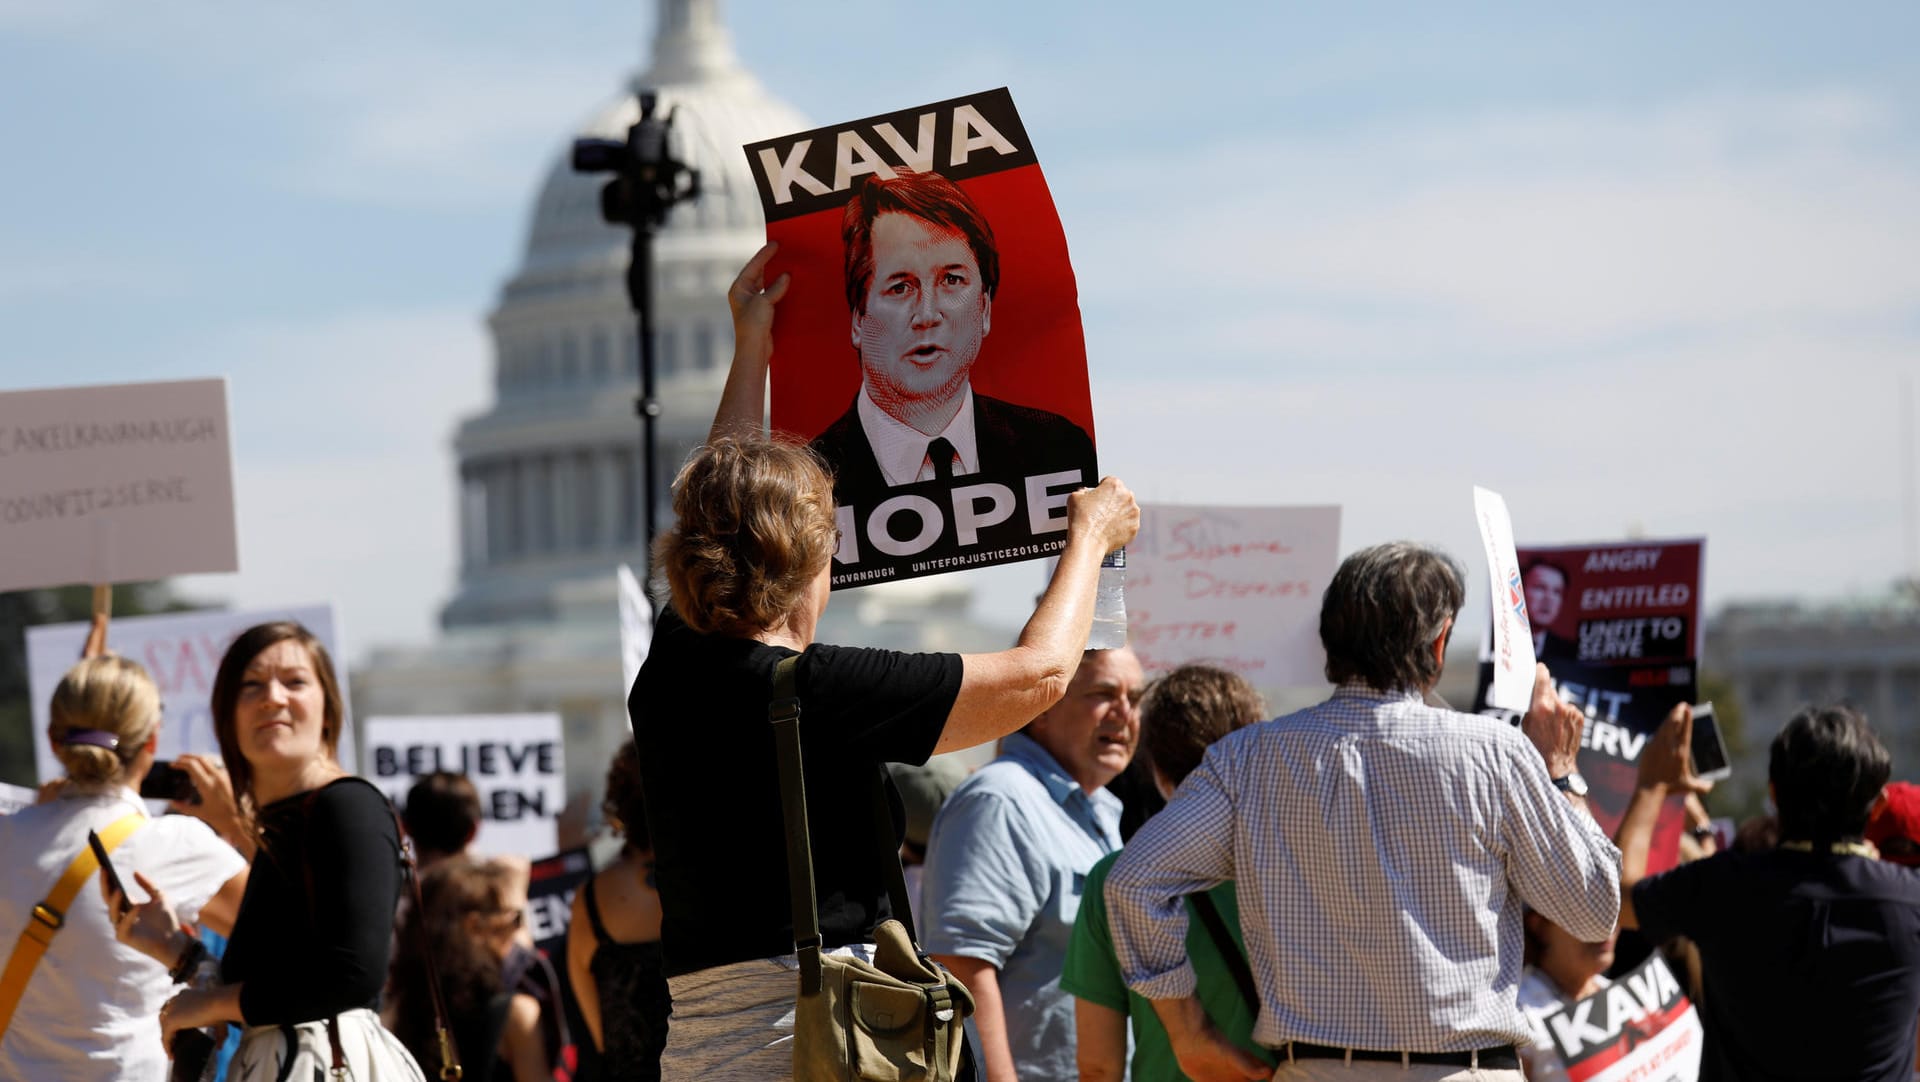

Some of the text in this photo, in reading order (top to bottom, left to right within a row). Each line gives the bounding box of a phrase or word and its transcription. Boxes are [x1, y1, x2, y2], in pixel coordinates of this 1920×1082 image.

[758, 104, 1019, 205] KAVA
[832, 540, 1067, 585] KAVANAUGH UNITEFORJUSTICE2018.COM
[1584, 551, 1662, 573] ANGRY
[1580, 584, 1690, 610] ENTITLED
[1579, 617, 1683, 641] UNFIT TO
[1578, 637, 1643, 660] SERVE
[375, 743, 556, 777] BELIEVE
[1551, 956, 1681, 1058] KAVA
